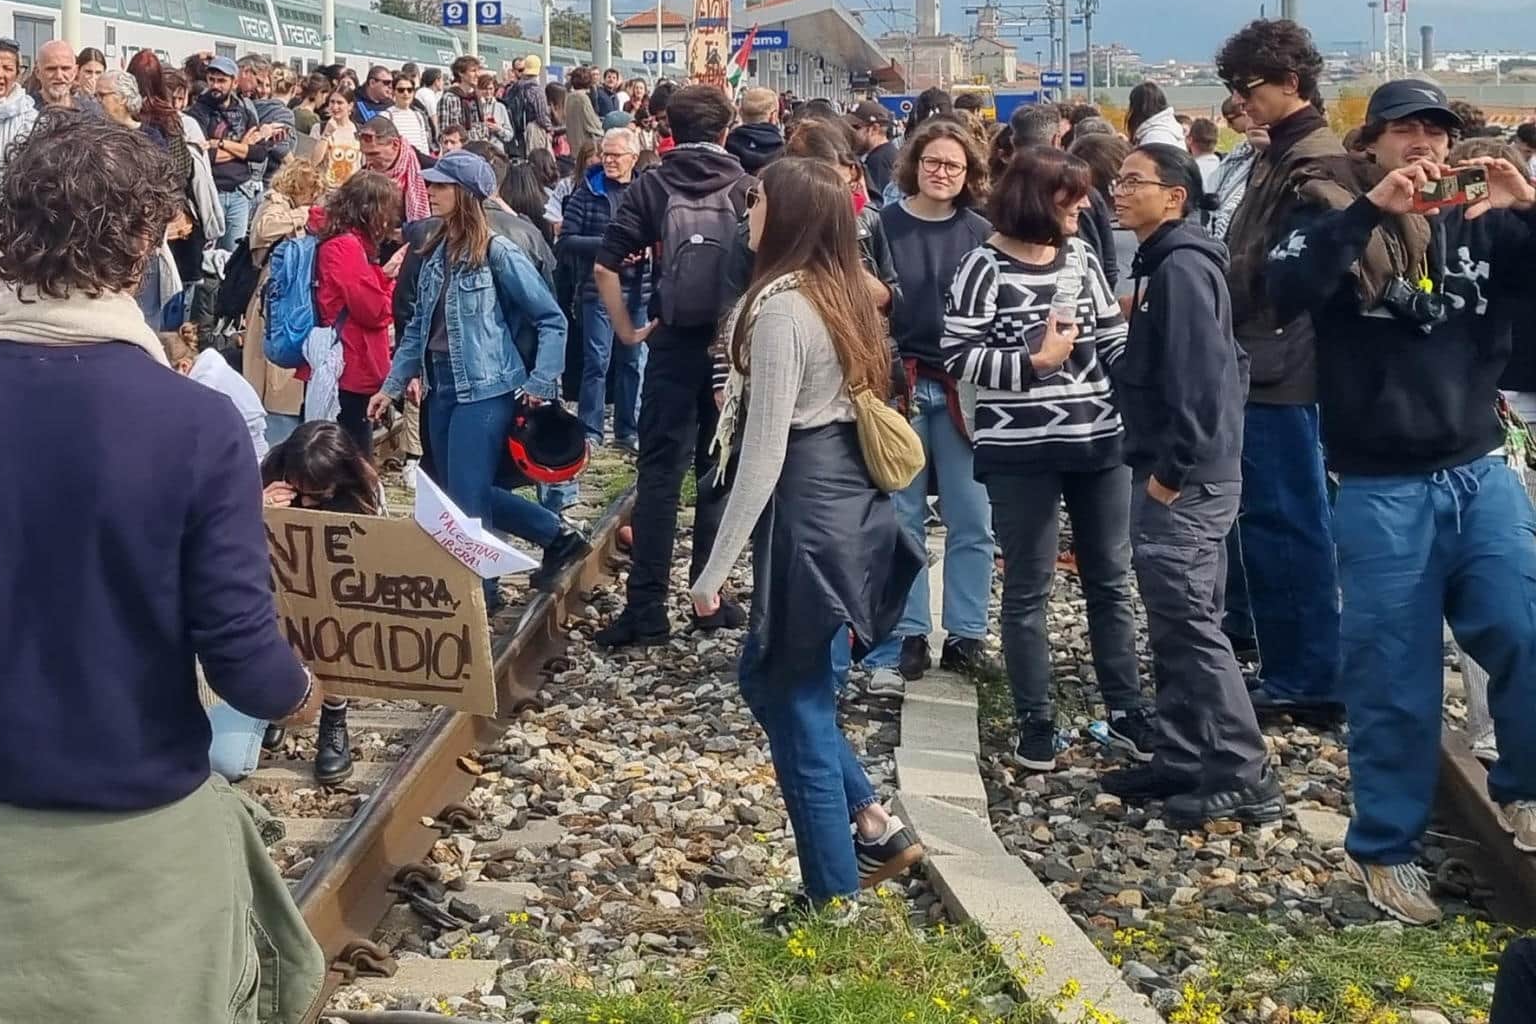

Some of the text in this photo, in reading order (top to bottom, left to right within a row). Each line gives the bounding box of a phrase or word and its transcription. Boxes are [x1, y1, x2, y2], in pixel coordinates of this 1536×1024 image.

[450, 6, 459, 16] 2
[731, 36, 782, 46] eramo
[439, 512, 500, 563] PALESTINA
[282, 614, 473, 681] NOCIDIO!
